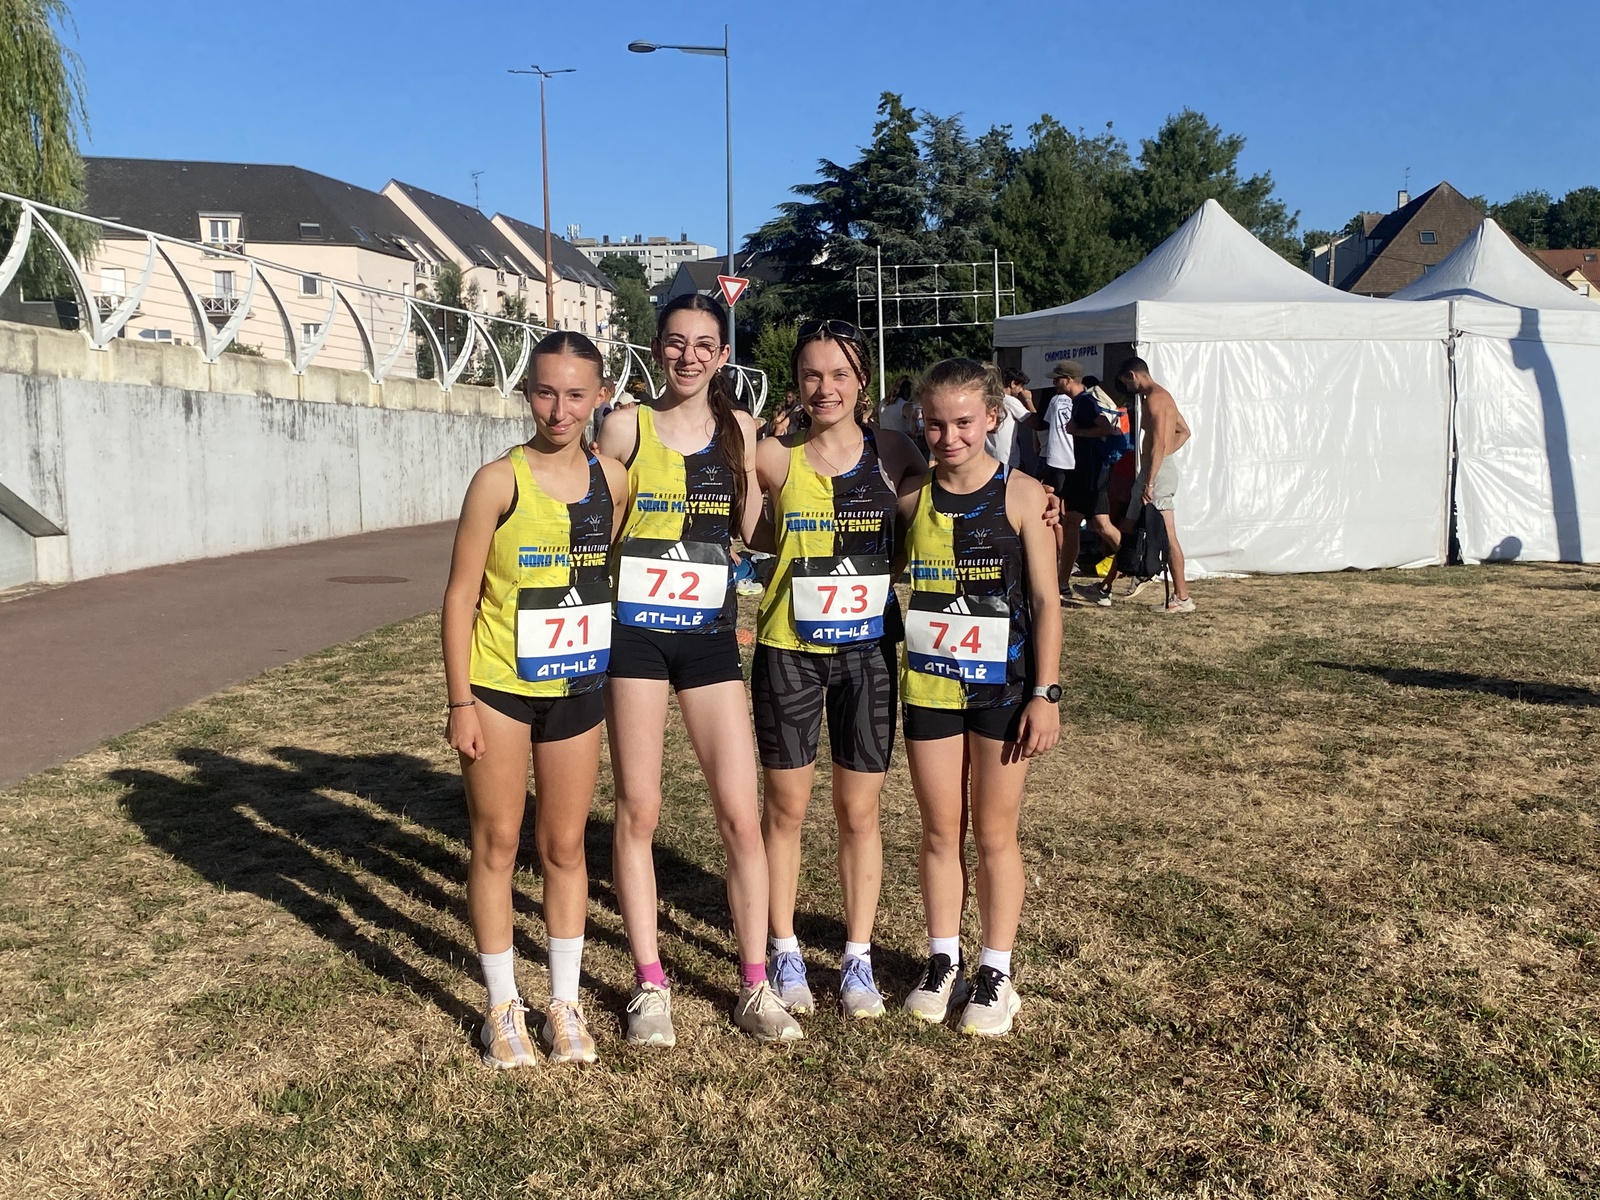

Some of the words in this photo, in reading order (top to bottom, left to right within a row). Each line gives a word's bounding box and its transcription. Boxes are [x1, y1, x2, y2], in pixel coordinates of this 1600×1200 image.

[637, 500, 669, 513] NORD
[671, 501, 731, 516] MAYENNE
[838, 510, 884, 518] ATHLETIQUE
[819, 519, 882, 533] MAYENNE
[518, 554, 553, 568] NORD
[925, 559, 954, 567] ENTENTE
[958, 558, 1004, 566] ATHLETIQUE
[942, 566, 1002, 581] MAYENNE
[646, 567, 700, 602] 7.2
[817, 584, 868, 614] 7.3
[634, 611, 704, 626] ATHLÉ
[545, 614, 589, 649] 7.1
[812, 621, 869, 640] ATHLÉ
[929, 621, 982, 654] 7.4
[537, 654, 597, 677] ATHLÉ
[924, 663, 987, 680] ATHLÉ
